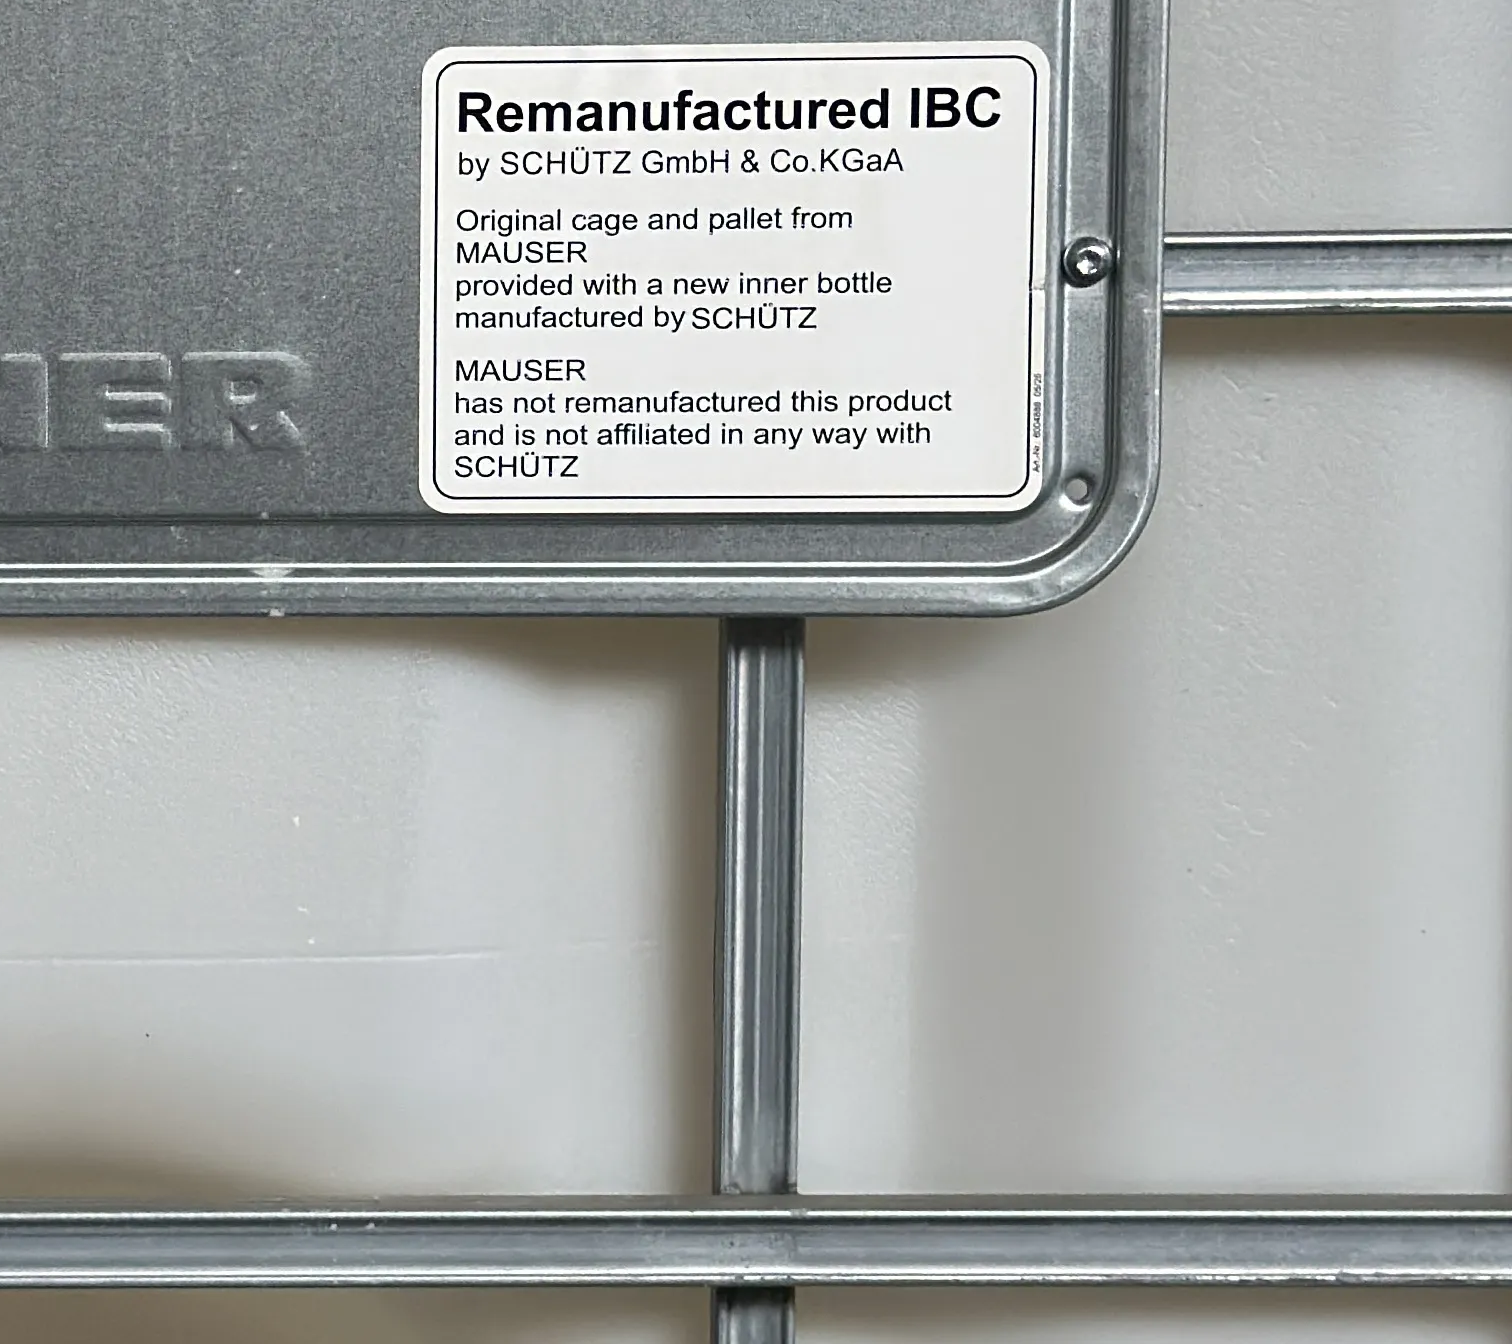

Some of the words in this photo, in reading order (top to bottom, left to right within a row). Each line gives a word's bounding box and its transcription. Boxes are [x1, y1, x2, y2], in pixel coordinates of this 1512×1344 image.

[458, 87, 890, 133] Remanufactured
[910, 86, 1001, 129] IBC
[458, 151, 490, 182] by
[500, 146, 632, 176] SCHÜTZ
[641, 149, 730, 174] GmbH
[740, 149, 760, 174] &
[770, 147, 904, 173] Co.KGaA
[456, 208, 561, 238] Original
[571, 213, 638, 237] cage
[647, 207, 698, 231] and
[709, 206, 783, 236] pallet
[791, 206, 853, 229] from
[456, 241, 588, 264] MAUSER
[456, 273, 573, 302] provided
[582, 272, 637, 296] with
[647, 278, 663, 296] a
[673, 277, 730, 295] new
[739, 272, 809, 295] inner
[817, 270, 893, 294] bottle
[455, 305, 643, 329] manufactured
[654, 305, 686, 333] by
[691, 302, 817, 330] SCHÜTZ
[455, 359, 586, 382] MAUSER
[455, 391, 503, 414] has
[513, 393, 556, 414] not
[565, 389, 781, 414] remanufactured
[791, 389, 839, 413] this
[848, 389, 952, 417] product
[454, 423, 504, 446] and
[515, 423, 536, 446] is
[545, 424, 589, 446] not
[596, 422, 710, 446] affiliated
[721, 422, 743, 445] in
[753, 427, 804, 450] any
[811, 427, 868, 450] way
[876, 421, 931, 444] with
[454, 451, 579, 478] SCHÜTZ
